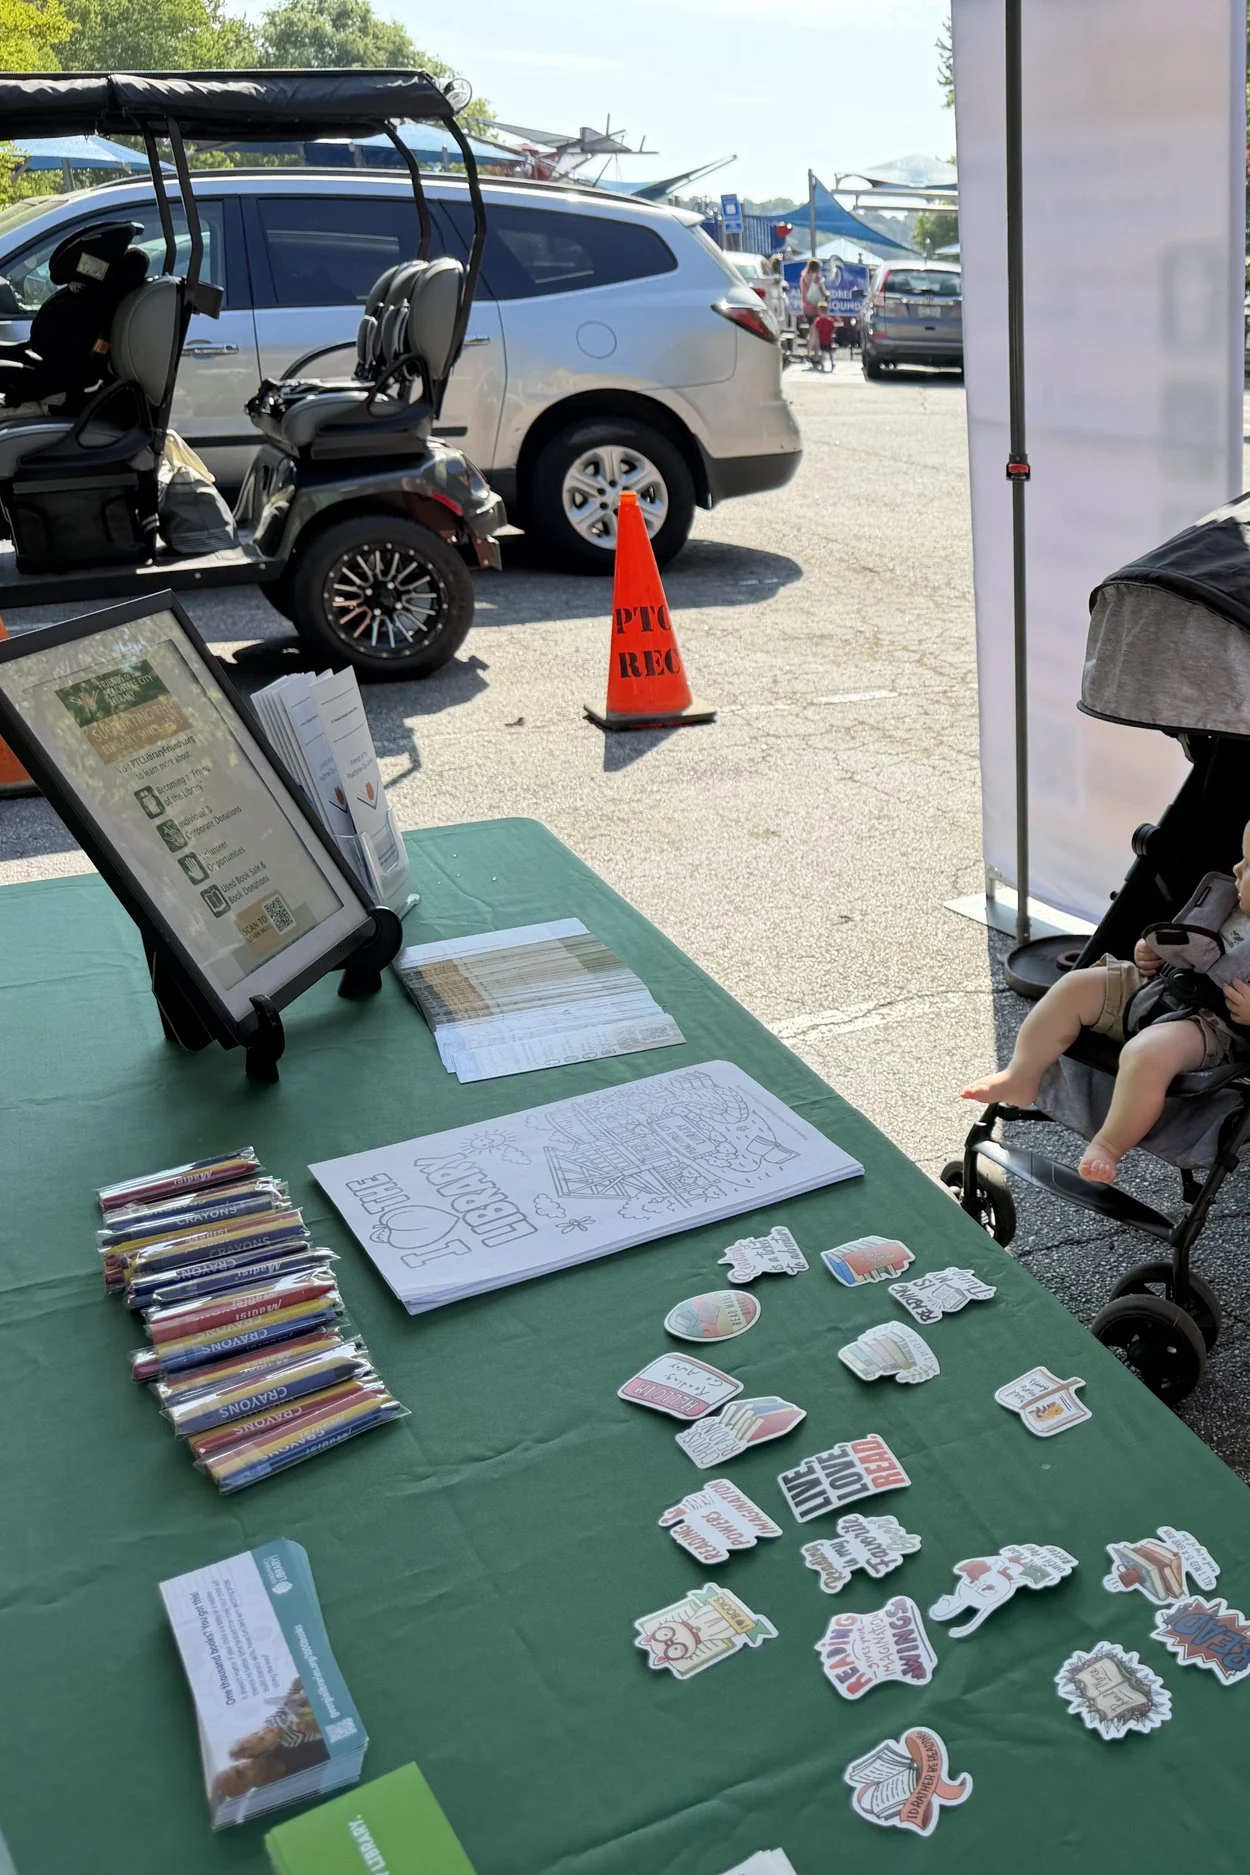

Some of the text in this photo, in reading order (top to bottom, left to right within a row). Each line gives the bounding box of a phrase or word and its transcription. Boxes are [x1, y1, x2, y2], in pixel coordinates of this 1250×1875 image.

[615, 605, 672, 634] PTC
[618, 648, 681, 678] REC
[140, 675, 153, 686] CITY
[130, 735, 196, 768] PTCLibraryFriends.org
[144, 765, 159, 778] learn
[159, 759, 176, 770] more
[156, 775, 187, 795] Becoming
[172, 793, 183, 804] the
[178, 808, 205, 828] Individual
[185, 806, 242, 840] Corporate Donations
[207, 847, 246, 873] Opportunities
[220, 879, 237, 893] Used
[235, 872, 250, 885] Book
[249, 864, 263, 876] Sale
[228, 875, 270, 904] Book Donations
[242, 915, 268, 936] SCAN TO
[413, 1152, 539, 1248] LIBRARY
[176, 1207, 238, 1226] CRAYONS
[345, 1173, 472, 1268] I THE
[209, 1236, 272, 1258] CRAYONS
[771, 1228, 806, 1273] to adventure
[174, 1258, 237, 1280] CRAYONS
[929, 1273, 954, 1285] MY
[913, 1279, 936, 1291] IS
[727, 1311, 743, 1326] READ
[892, 1285, 939, 1323] READING
[201, 1329, 268, 1354] CRAYONS
[706, 1376, 724, 1388] Go
[218, 1386, 288, 1418] CRAYONS
[654, 1389, 701, 1412] HELLO
[234, 1407, 303, 1435] CRAYONS
[681, 1429, 720, 1466] CHOOSE
[696, 1418, 742, 1457] READING
[815, 1444, 871, 1502] LOVE,
[781, 1459, 833, 1519] LIVE,
[707, 1480, 779, 1535] IMAGINATION
[673, 1524, 723, 1561] READING
[702, 1511, 751, 1546] POWERS
[829, 1540, 851, 1557] my
[841, 1516, 899, 1575] Favorite
[804, 1543, 847, 1590] Reading
[195, 1604, 208, 1617] got
[713, 1596, 740, 1620] BOOKS
[198, 1617, 210, 1631] You
[202, 1630, 219, 1655] books?
[869, 1613, 898, 1676] IMAGINATION
[885, 1599, 927, 1680] WINGS
[820, 1615, 873, 1696] READING
[210, 1654, 230, 1690] thousand
[222, 1689, 236, 1706] One
[1090, 1667, 1125, 1711] Read More
[915, 1731, 938, 1762] READING
[927, 1762, 938, 1774] BE
[912, 1774, 935, 1808] RATHER
